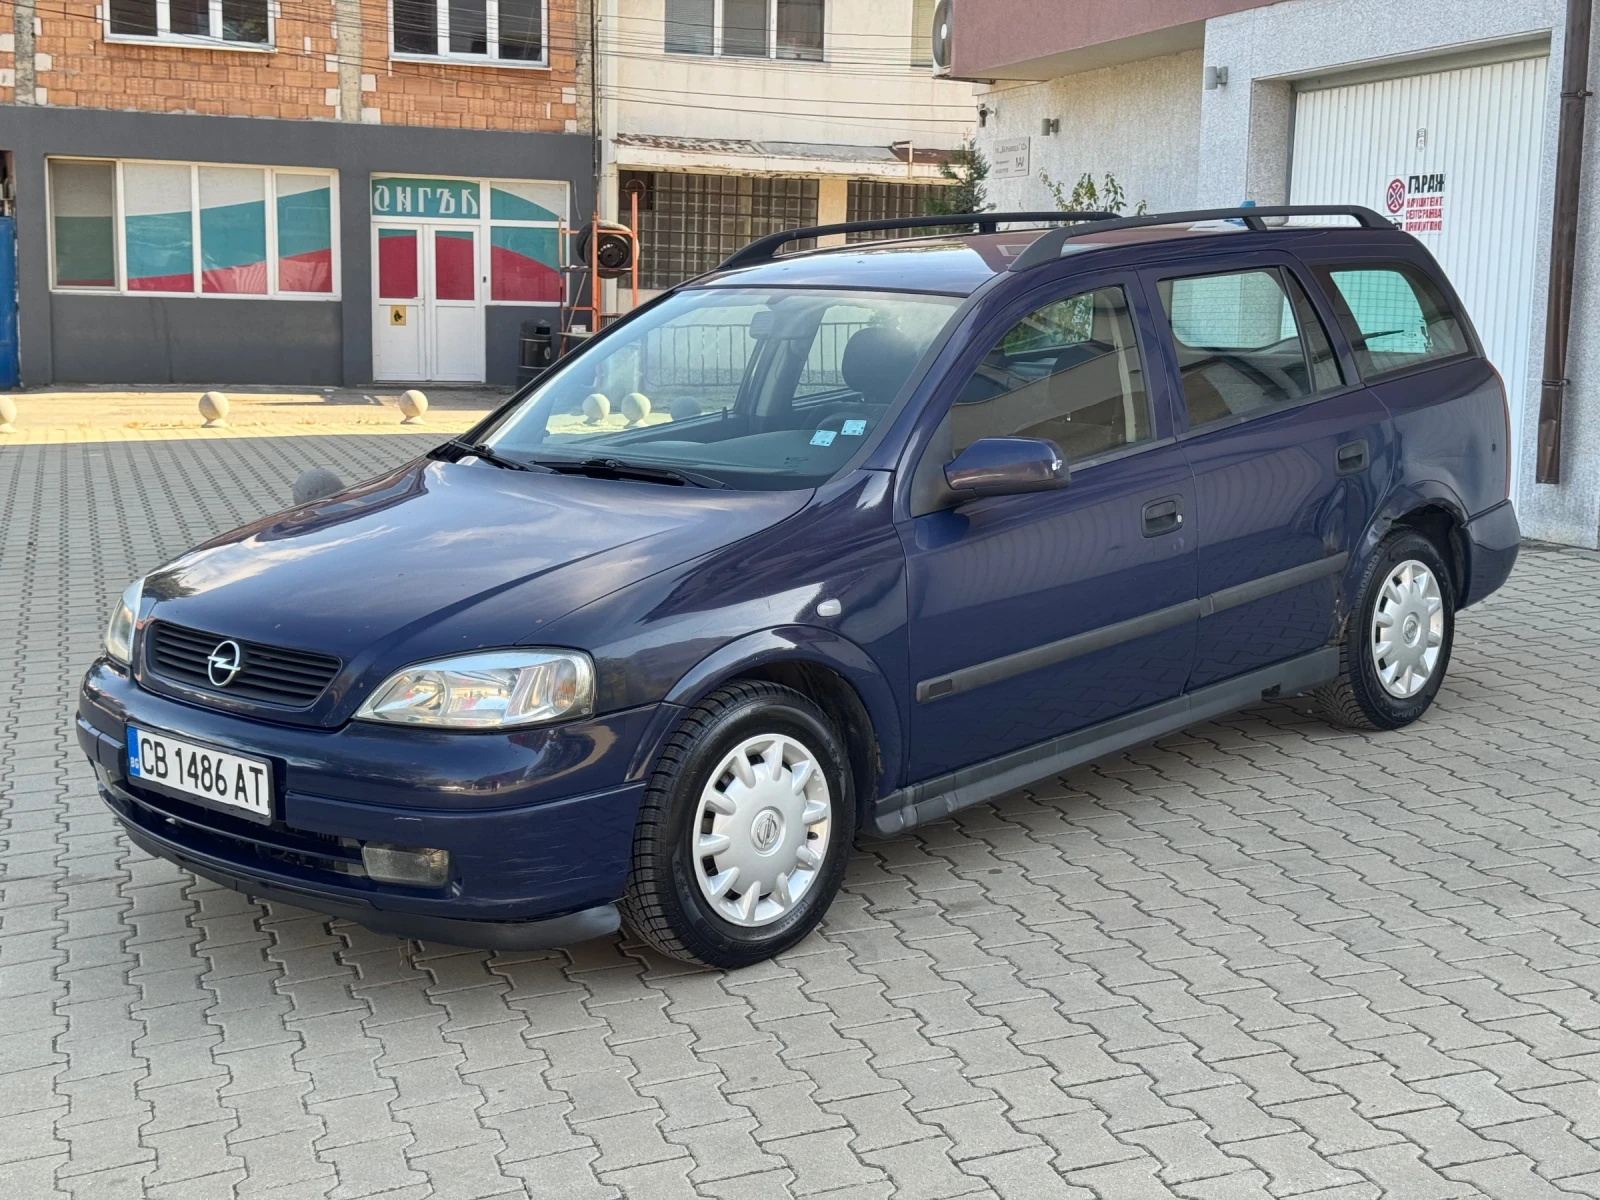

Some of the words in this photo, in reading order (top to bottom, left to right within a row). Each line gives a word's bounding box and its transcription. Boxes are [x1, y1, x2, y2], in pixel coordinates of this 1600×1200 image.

[1408, 173, 1446, 194] ГАРАЖ
[1391, 701, 1423, 718] KUMHO
[130, 756, 140, 769] BG
[141, 738, 168, 779] CB
[175, 748, 228, 796] 1486
[235, 763, 264, 807] AT
